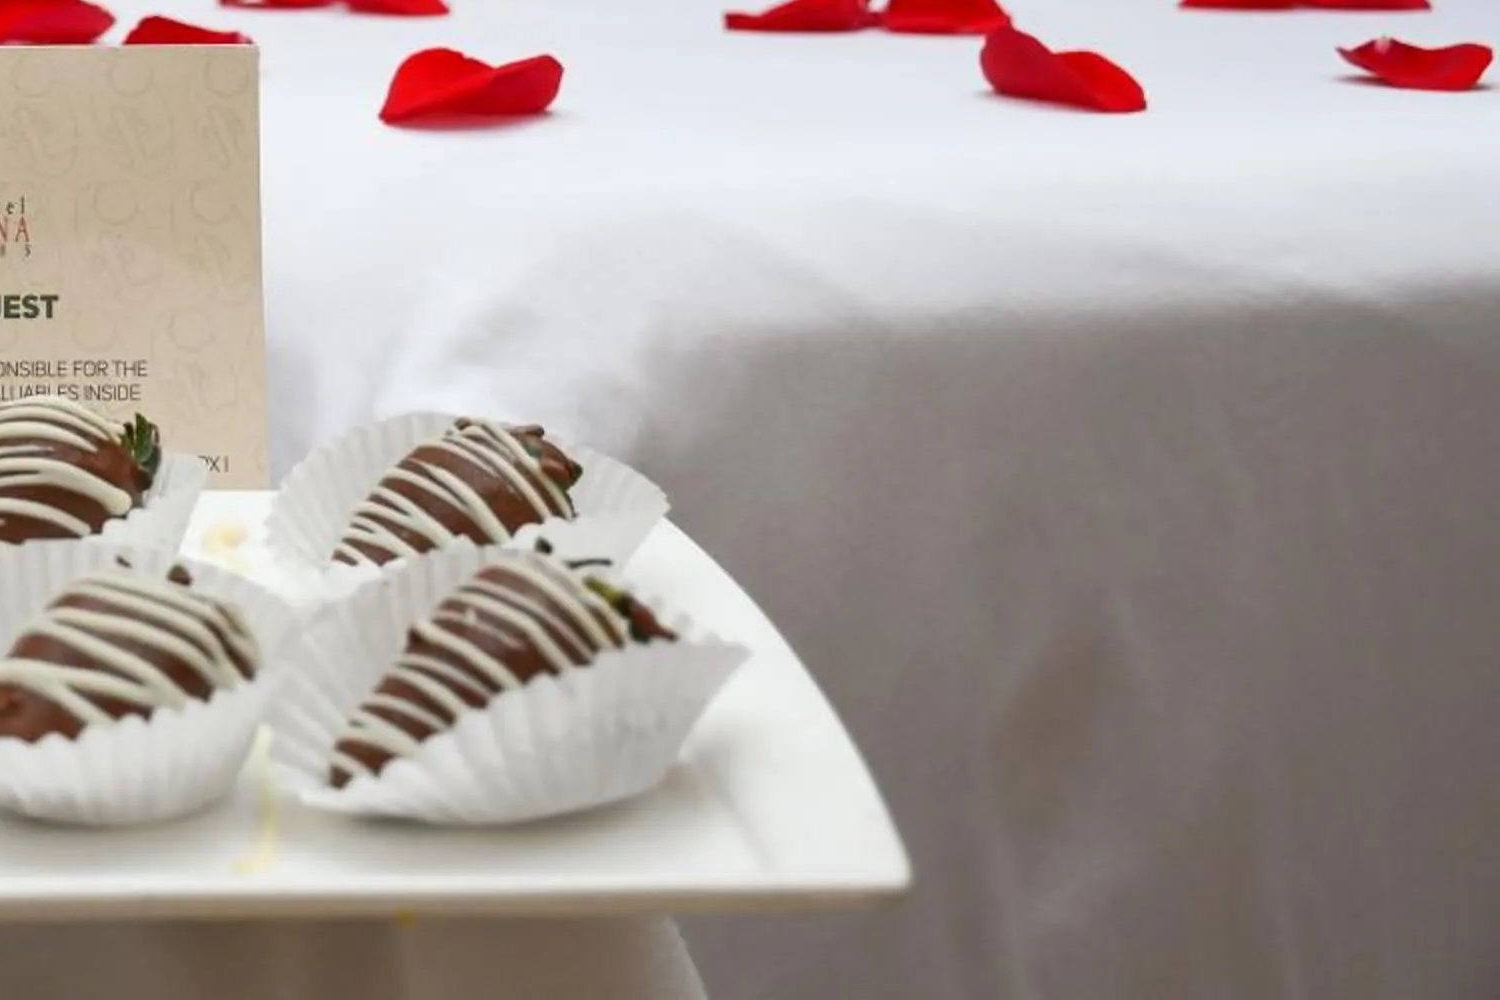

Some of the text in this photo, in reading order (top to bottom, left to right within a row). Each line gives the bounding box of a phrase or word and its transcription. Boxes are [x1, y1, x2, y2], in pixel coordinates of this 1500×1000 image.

[73, 360, 108, 377] FOR
[112, 360, 148, 377] THE
[84, 384, 141, 401] INSIDE
